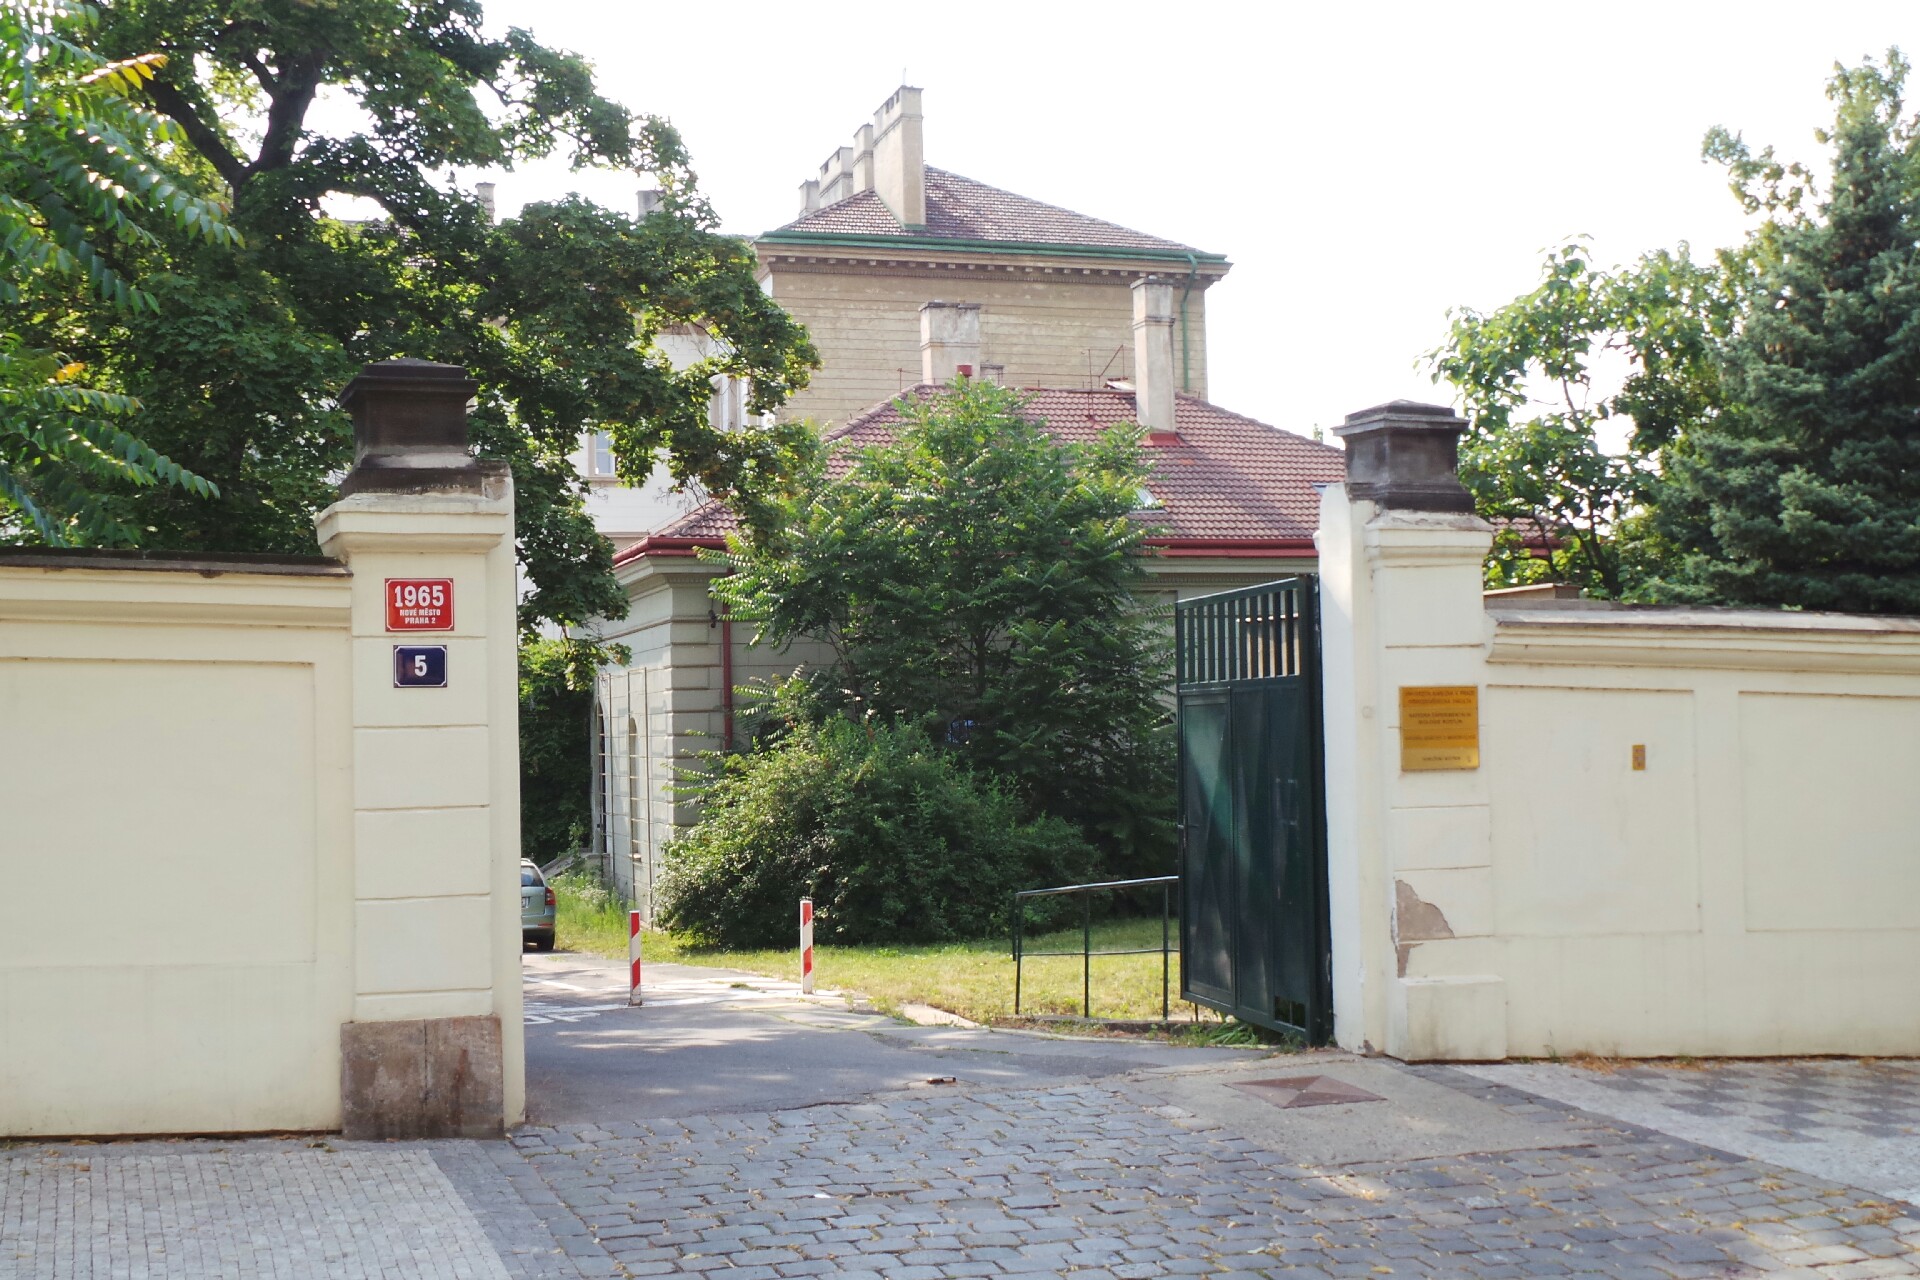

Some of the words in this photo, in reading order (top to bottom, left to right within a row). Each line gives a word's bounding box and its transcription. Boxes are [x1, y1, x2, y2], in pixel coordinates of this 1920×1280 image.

[395, 585, 444, 607] 1965
[400, 608, 417, 616] NOVÉ
[418, 608, 441, 616] MĚSTO
[414, 655, 427, 677] 5
